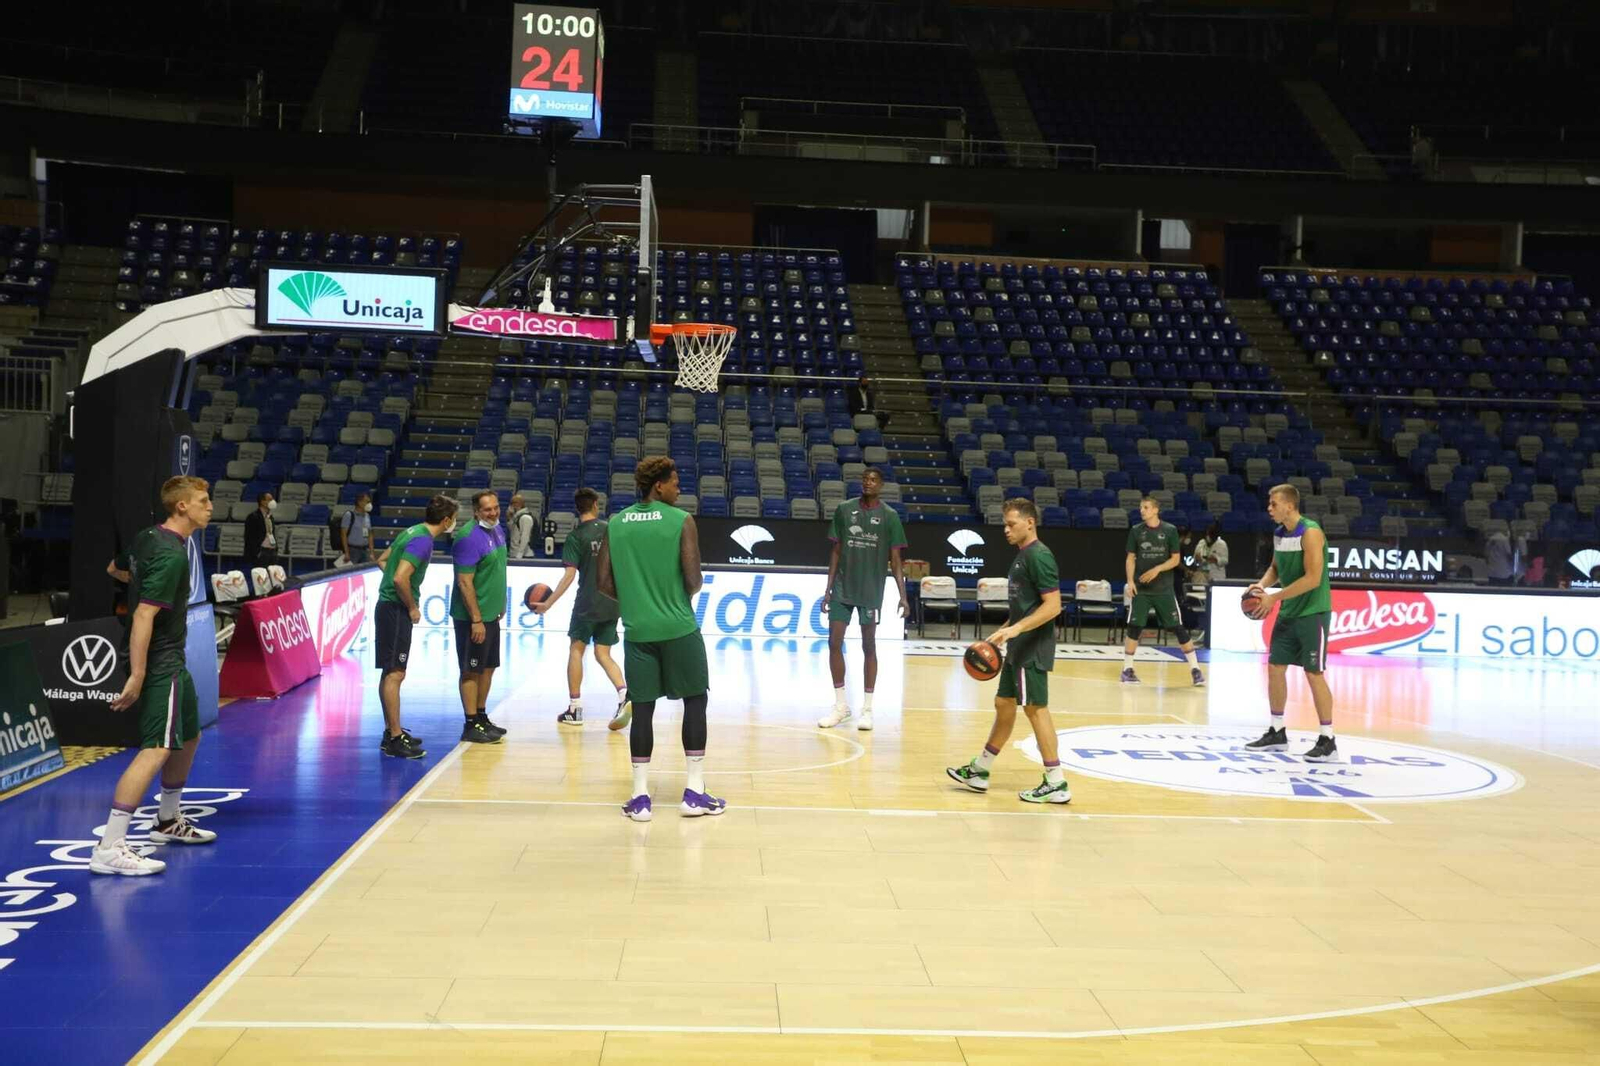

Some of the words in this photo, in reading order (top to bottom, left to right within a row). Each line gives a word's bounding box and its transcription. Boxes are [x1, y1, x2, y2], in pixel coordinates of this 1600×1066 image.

[522, 12, 595, 38] 10:00
[520, 45, 584, 91] 24
[343, 298, 424, 323] Unicaja
[468, 311, 577, 337] endesa
[1344, 547, 1443, 572] ANSAN
[259, 606, 311, 654] endesa
[1481, 616, 1600, 658] sabo
[87, 690, 121, 703] Wage
[0, 703, 55, 757] nicaja
[1071, 748, 1447, 768] PEDRIAS
